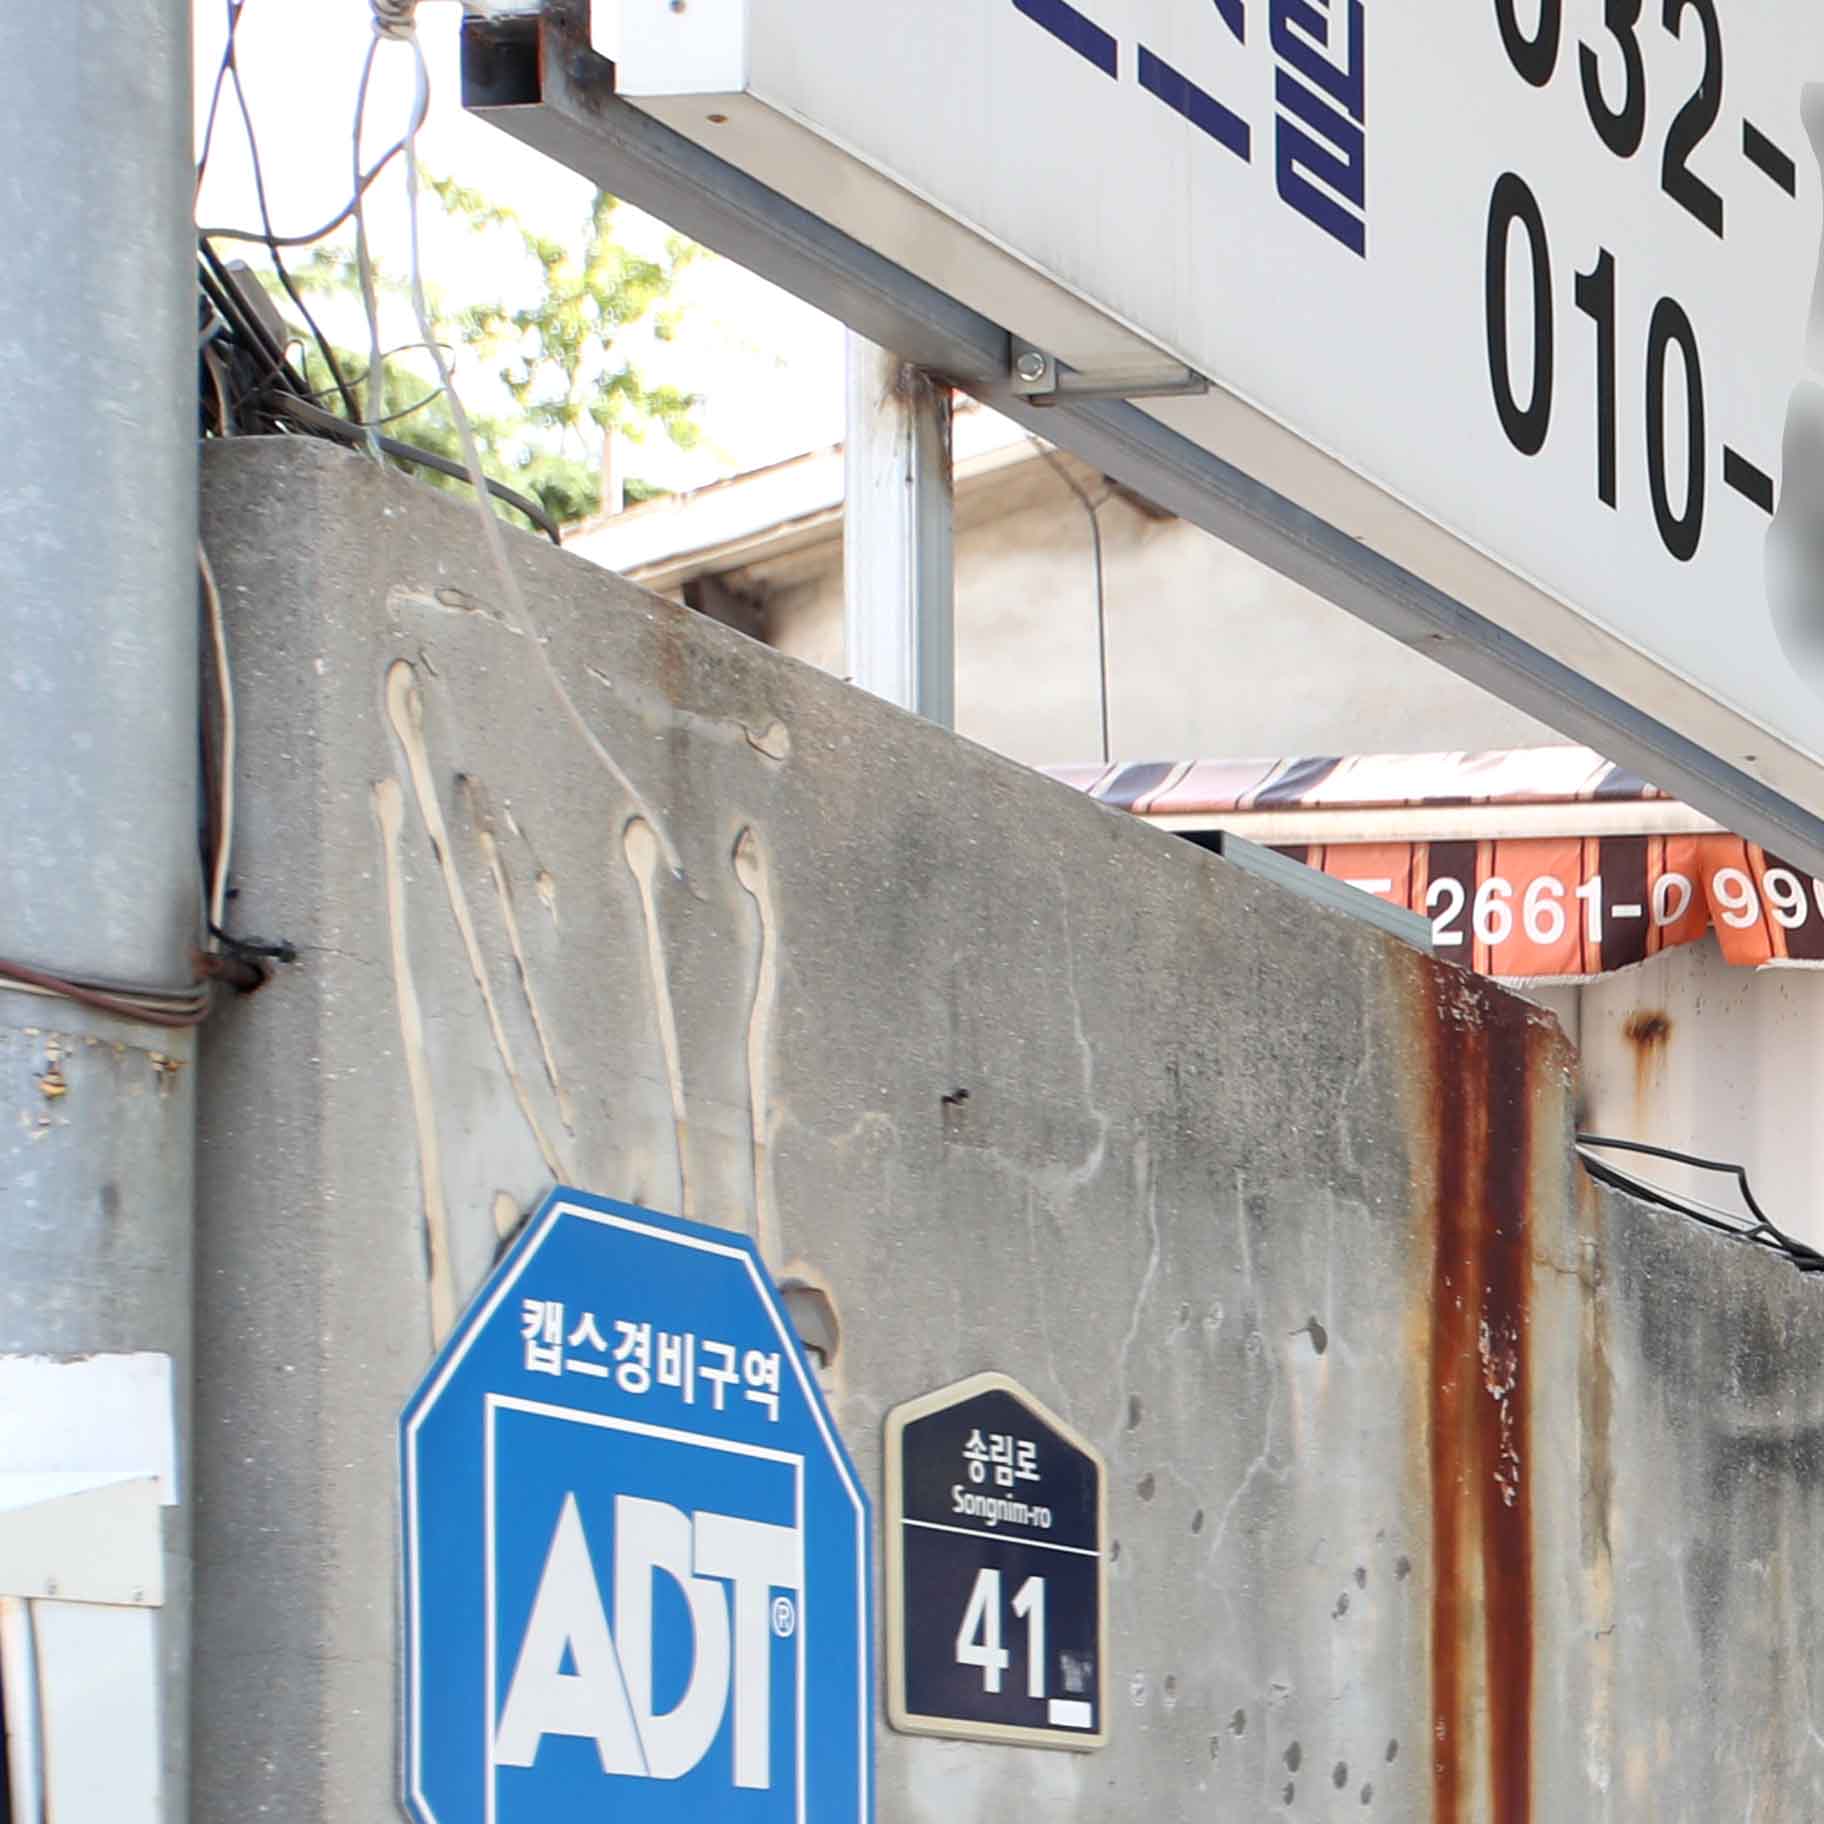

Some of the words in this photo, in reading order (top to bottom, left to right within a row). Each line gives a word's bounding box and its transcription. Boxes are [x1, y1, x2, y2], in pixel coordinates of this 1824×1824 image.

[520, 1298, 781, 1422] 캡스경비구역
[952, 1485, 1051, 1528] Songnim-ro
[962, 1428, 1041, 1487] 송림로
[494, 1490, 800, 1790] ADT
[955, 1567, 1046, 1698] 41
